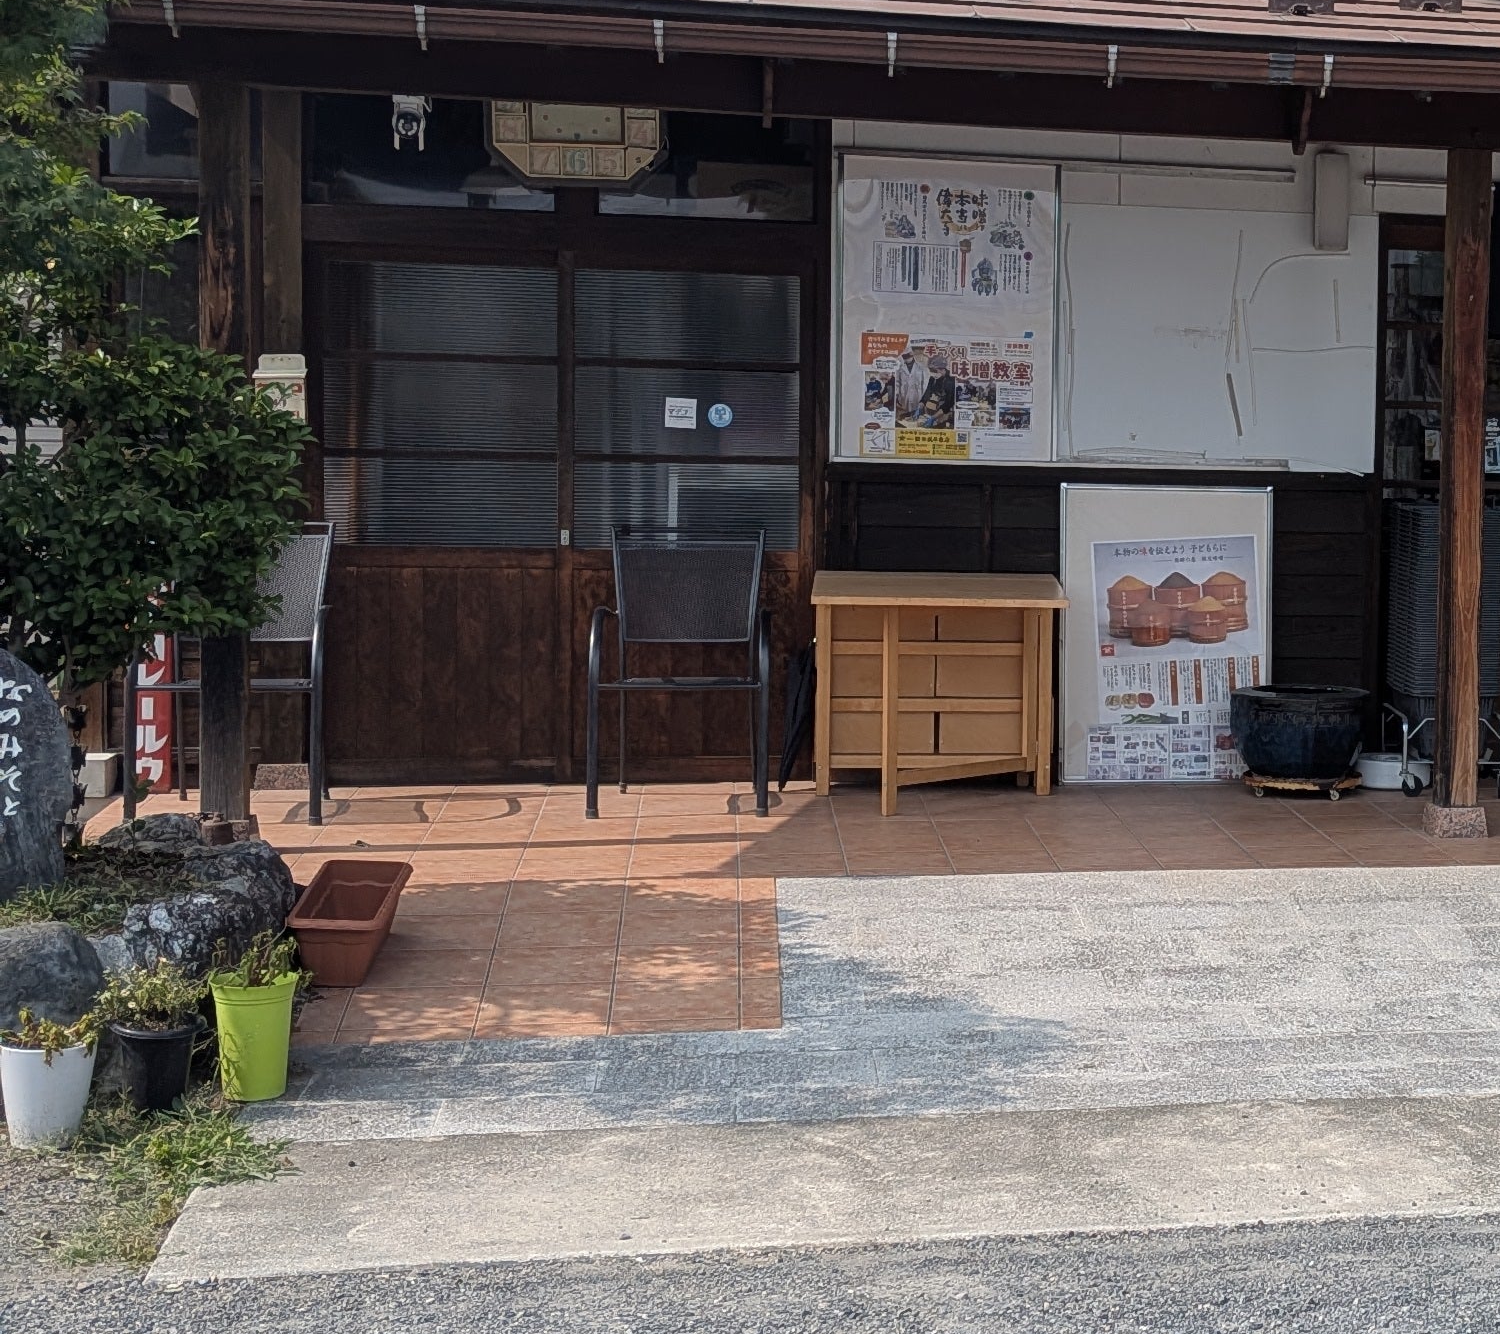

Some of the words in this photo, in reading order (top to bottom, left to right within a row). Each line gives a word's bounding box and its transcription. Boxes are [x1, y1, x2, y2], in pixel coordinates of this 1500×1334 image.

[924, 344, 965, 358] 手づくり
[951, 361, 1032, 381] 味噌教室
[1113, 545, 1186, 557] 本物の味を伝えよう
[1189, 543, 1228, 554] 子どもらに
